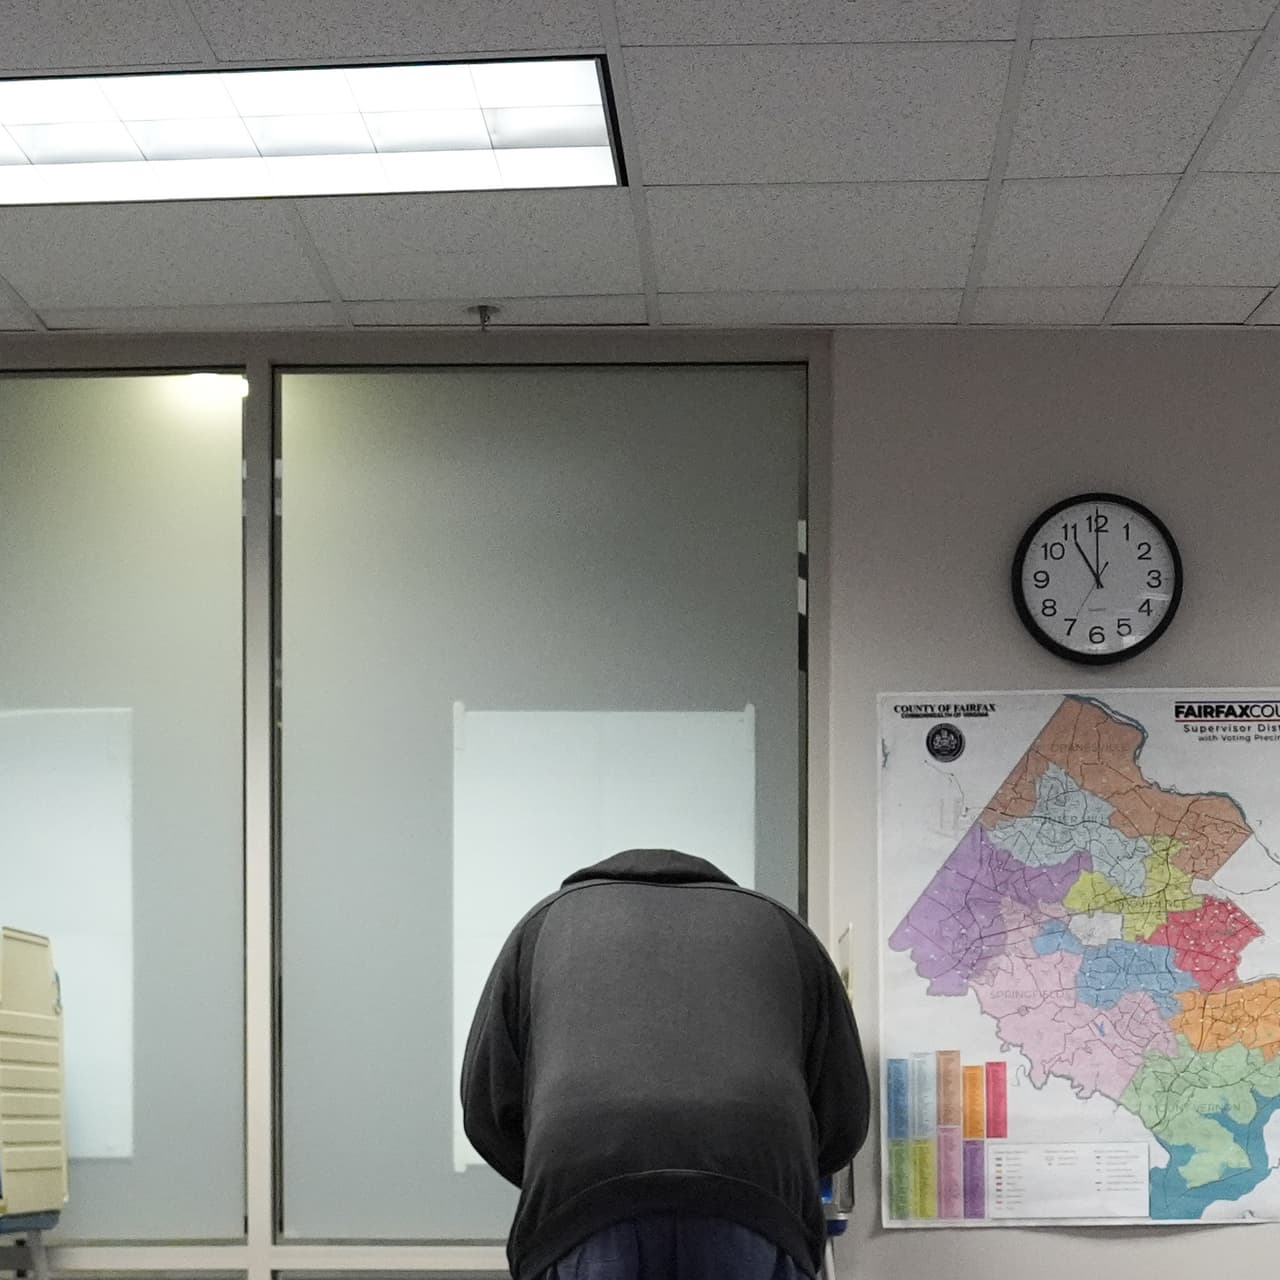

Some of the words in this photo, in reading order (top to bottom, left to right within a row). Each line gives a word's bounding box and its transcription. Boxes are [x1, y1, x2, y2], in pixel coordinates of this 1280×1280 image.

[1062, 523, 1078, 541] 11
[1086, 515, 1109, 533] 12
[1123, 523, 1130, 541] 1
[1041, 542, 1065, 560] 10
[1137, 542, 1152, 560] 2
[1033, 570, 1050, 589] 9
[1147, 570, 1162, 588] 3
[1041, 599, 1057, 617] 8
[1138, 599, 1153, 616] 4
[1064, 618, 1077, 636] 7
[1089, 626, 1105, 644] 6
[1117, 618, 1132, 636] 5
[894, 704, 935, 713] COUNTY
[937, 704, 950, 712] OF
[954, 703, 996, 712] FAIRFAX
[1183, 724, 1252, 734] Supervisor
[1221, 734, 1251, 742] Voting
